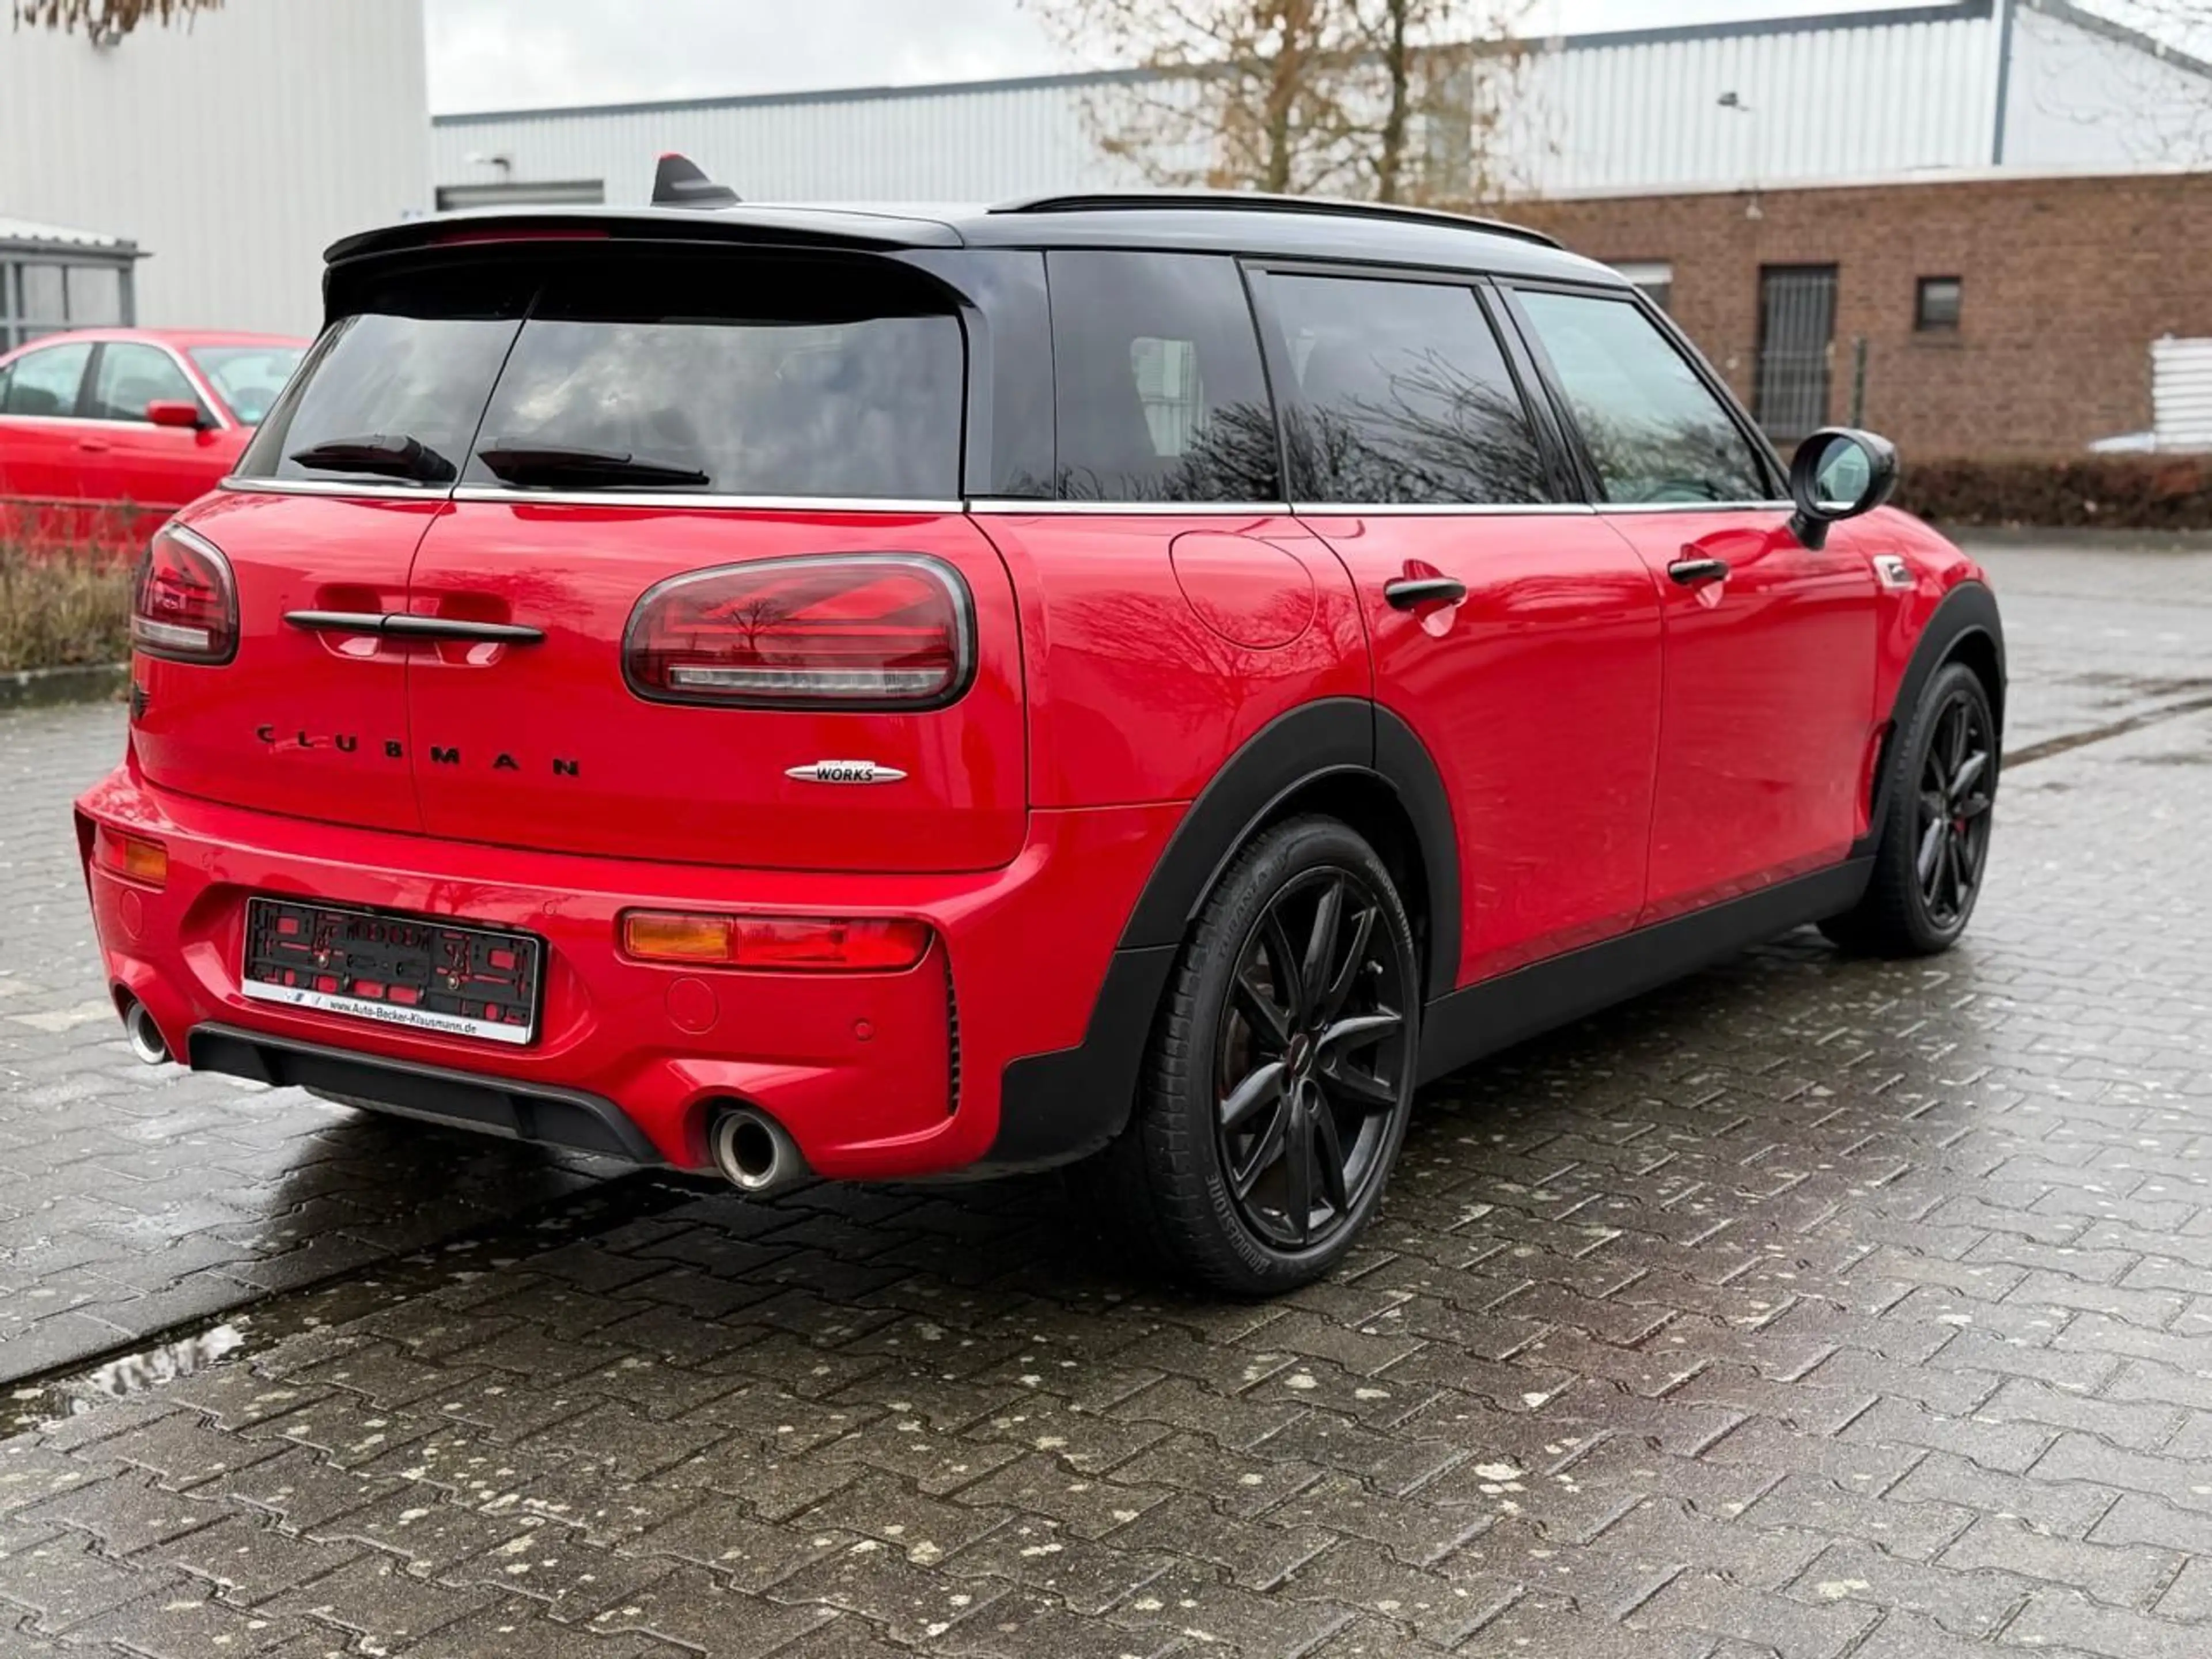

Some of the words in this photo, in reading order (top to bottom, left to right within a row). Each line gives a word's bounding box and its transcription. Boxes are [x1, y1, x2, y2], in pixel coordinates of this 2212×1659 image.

[255, 725, 579, 777] CLUBMAN
[816, 767, 874, 781] WORKS
[329, 1001, 477, 1035] www.Auto-Becker-Klausmann.de
[1205, 1172, 1272, 1274] BRIDGESTONE
